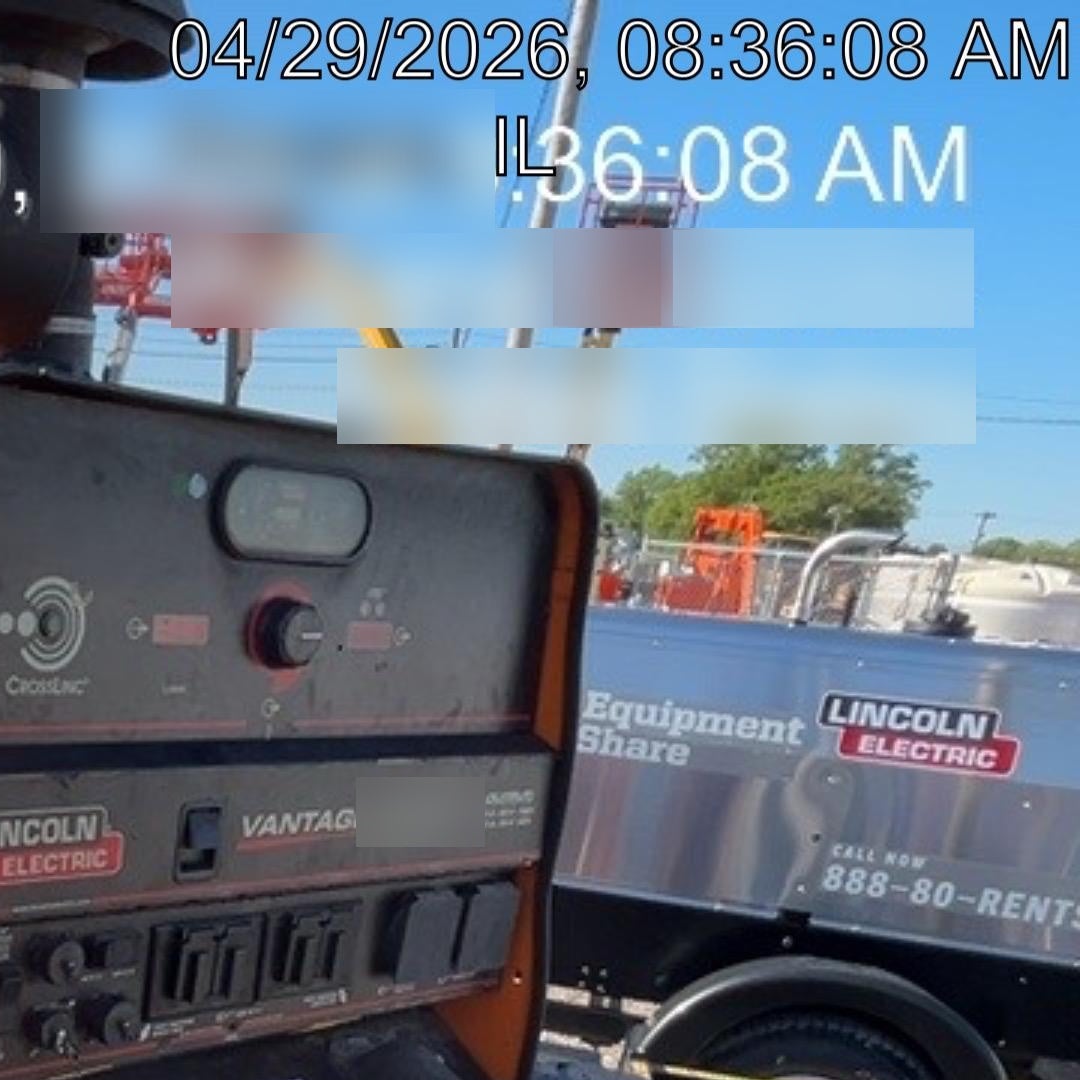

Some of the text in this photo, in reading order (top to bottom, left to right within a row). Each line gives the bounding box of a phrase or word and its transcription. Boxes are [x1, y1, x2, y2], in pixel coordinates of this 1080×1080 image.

[581, 690, 806, 746] Equipment
[826, 698, 989, 739] LINCOLN
[577, 725, 692, 767] Share
[857, 734, 999, 769] ELECTRIC
[241, 807, 357, 838] VANTAG
[1, 847, 110, 876] ELECTRIC
[832, 844, 928, 868] CALL NOW
